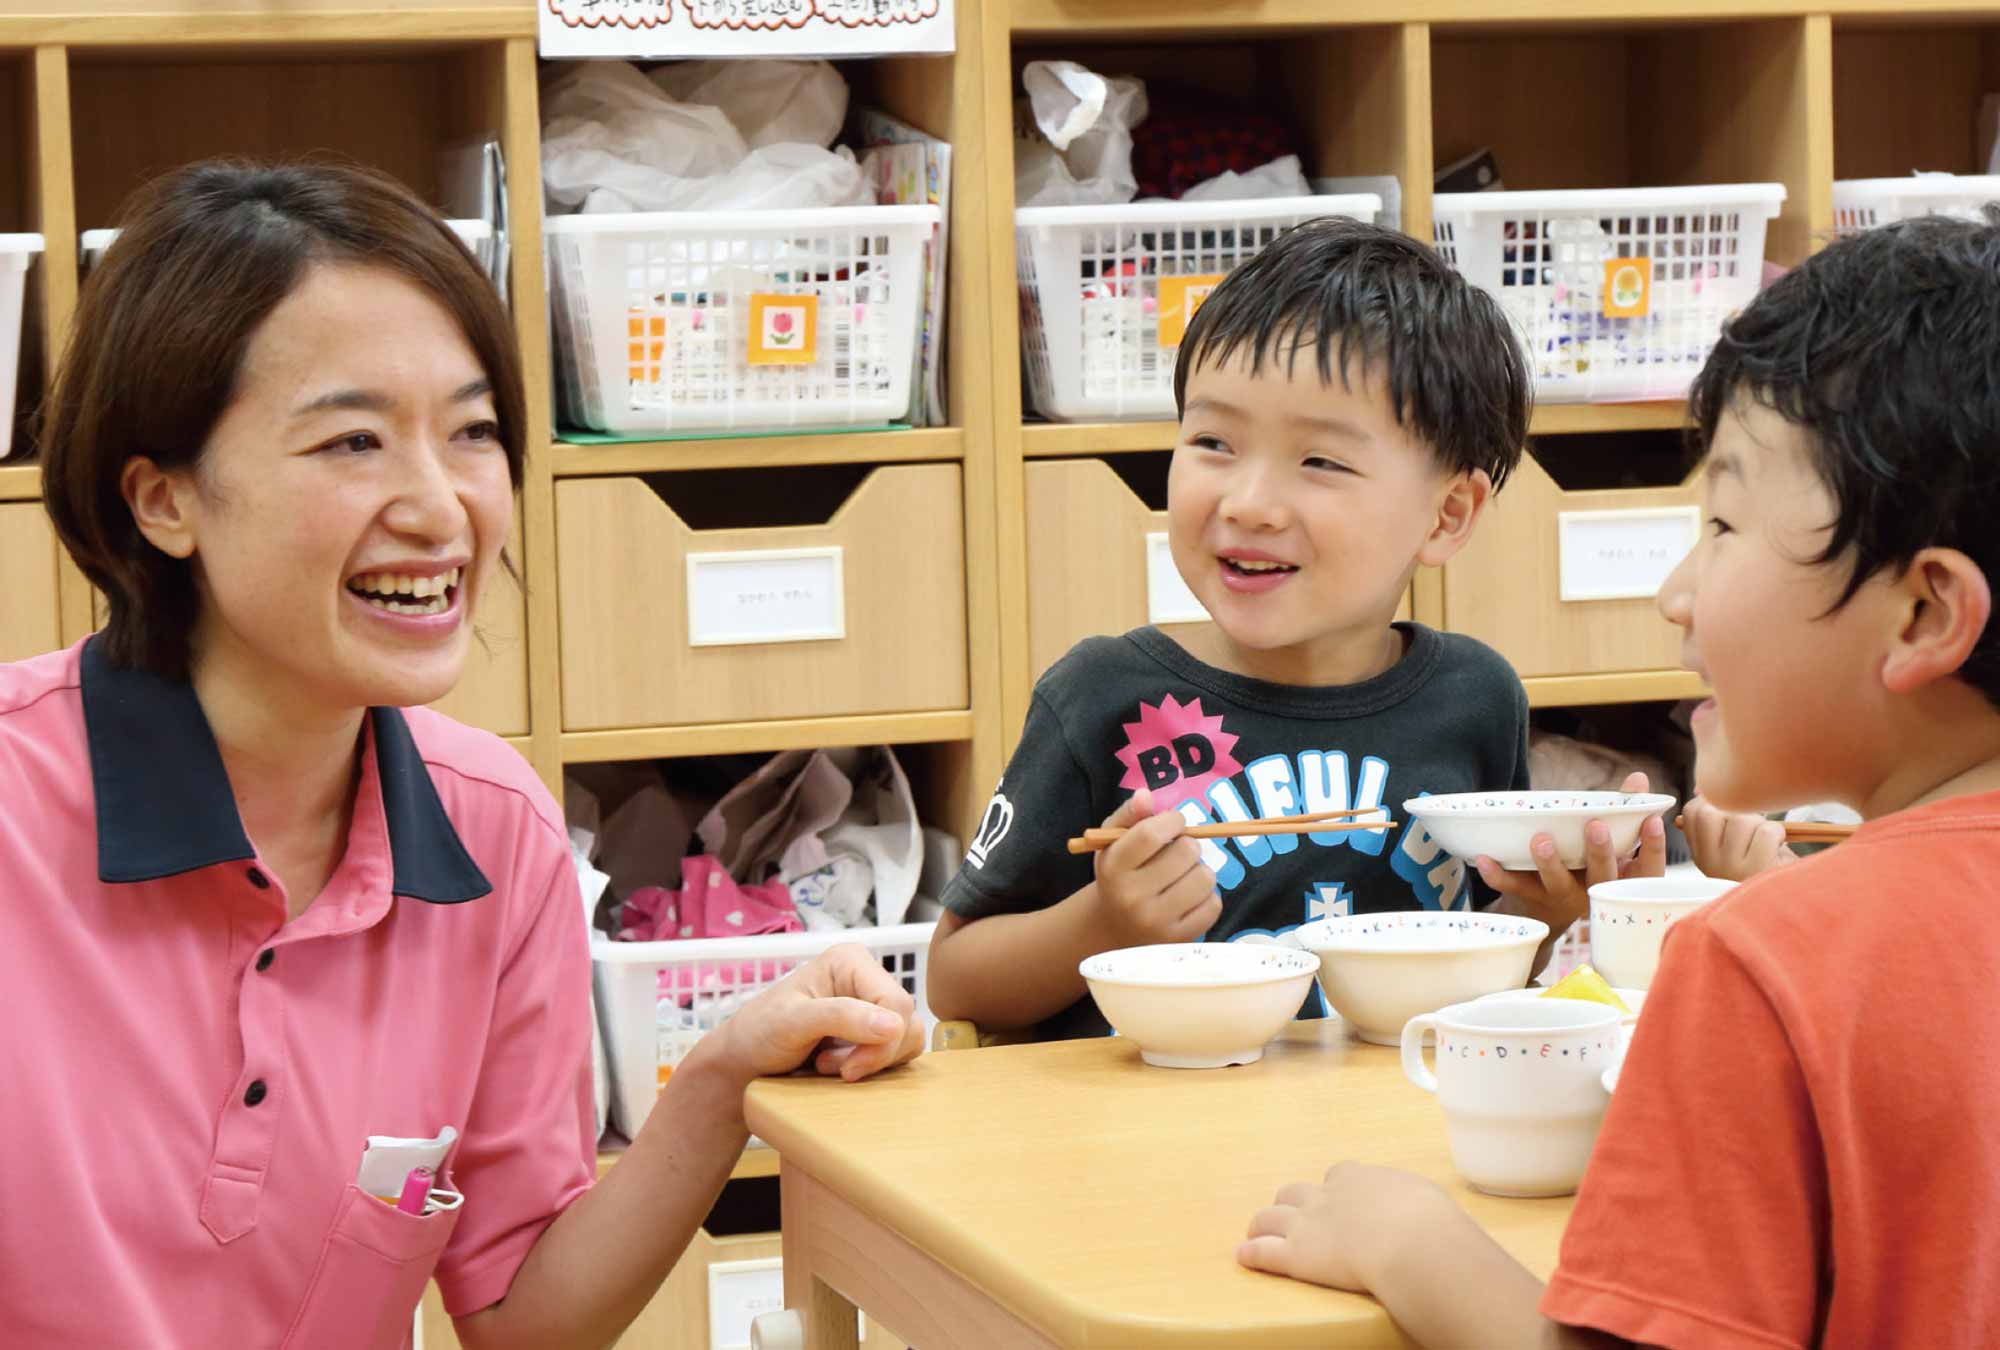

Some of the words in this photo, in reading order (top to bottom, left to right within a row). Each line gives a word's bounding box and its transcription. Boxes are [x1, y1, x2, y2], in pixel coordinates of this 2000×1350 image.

[1138, 732, 1216, 793] BD
[1496, 1045, 1508, 1058] D
[1540, 1043, 1551, 1057] E
